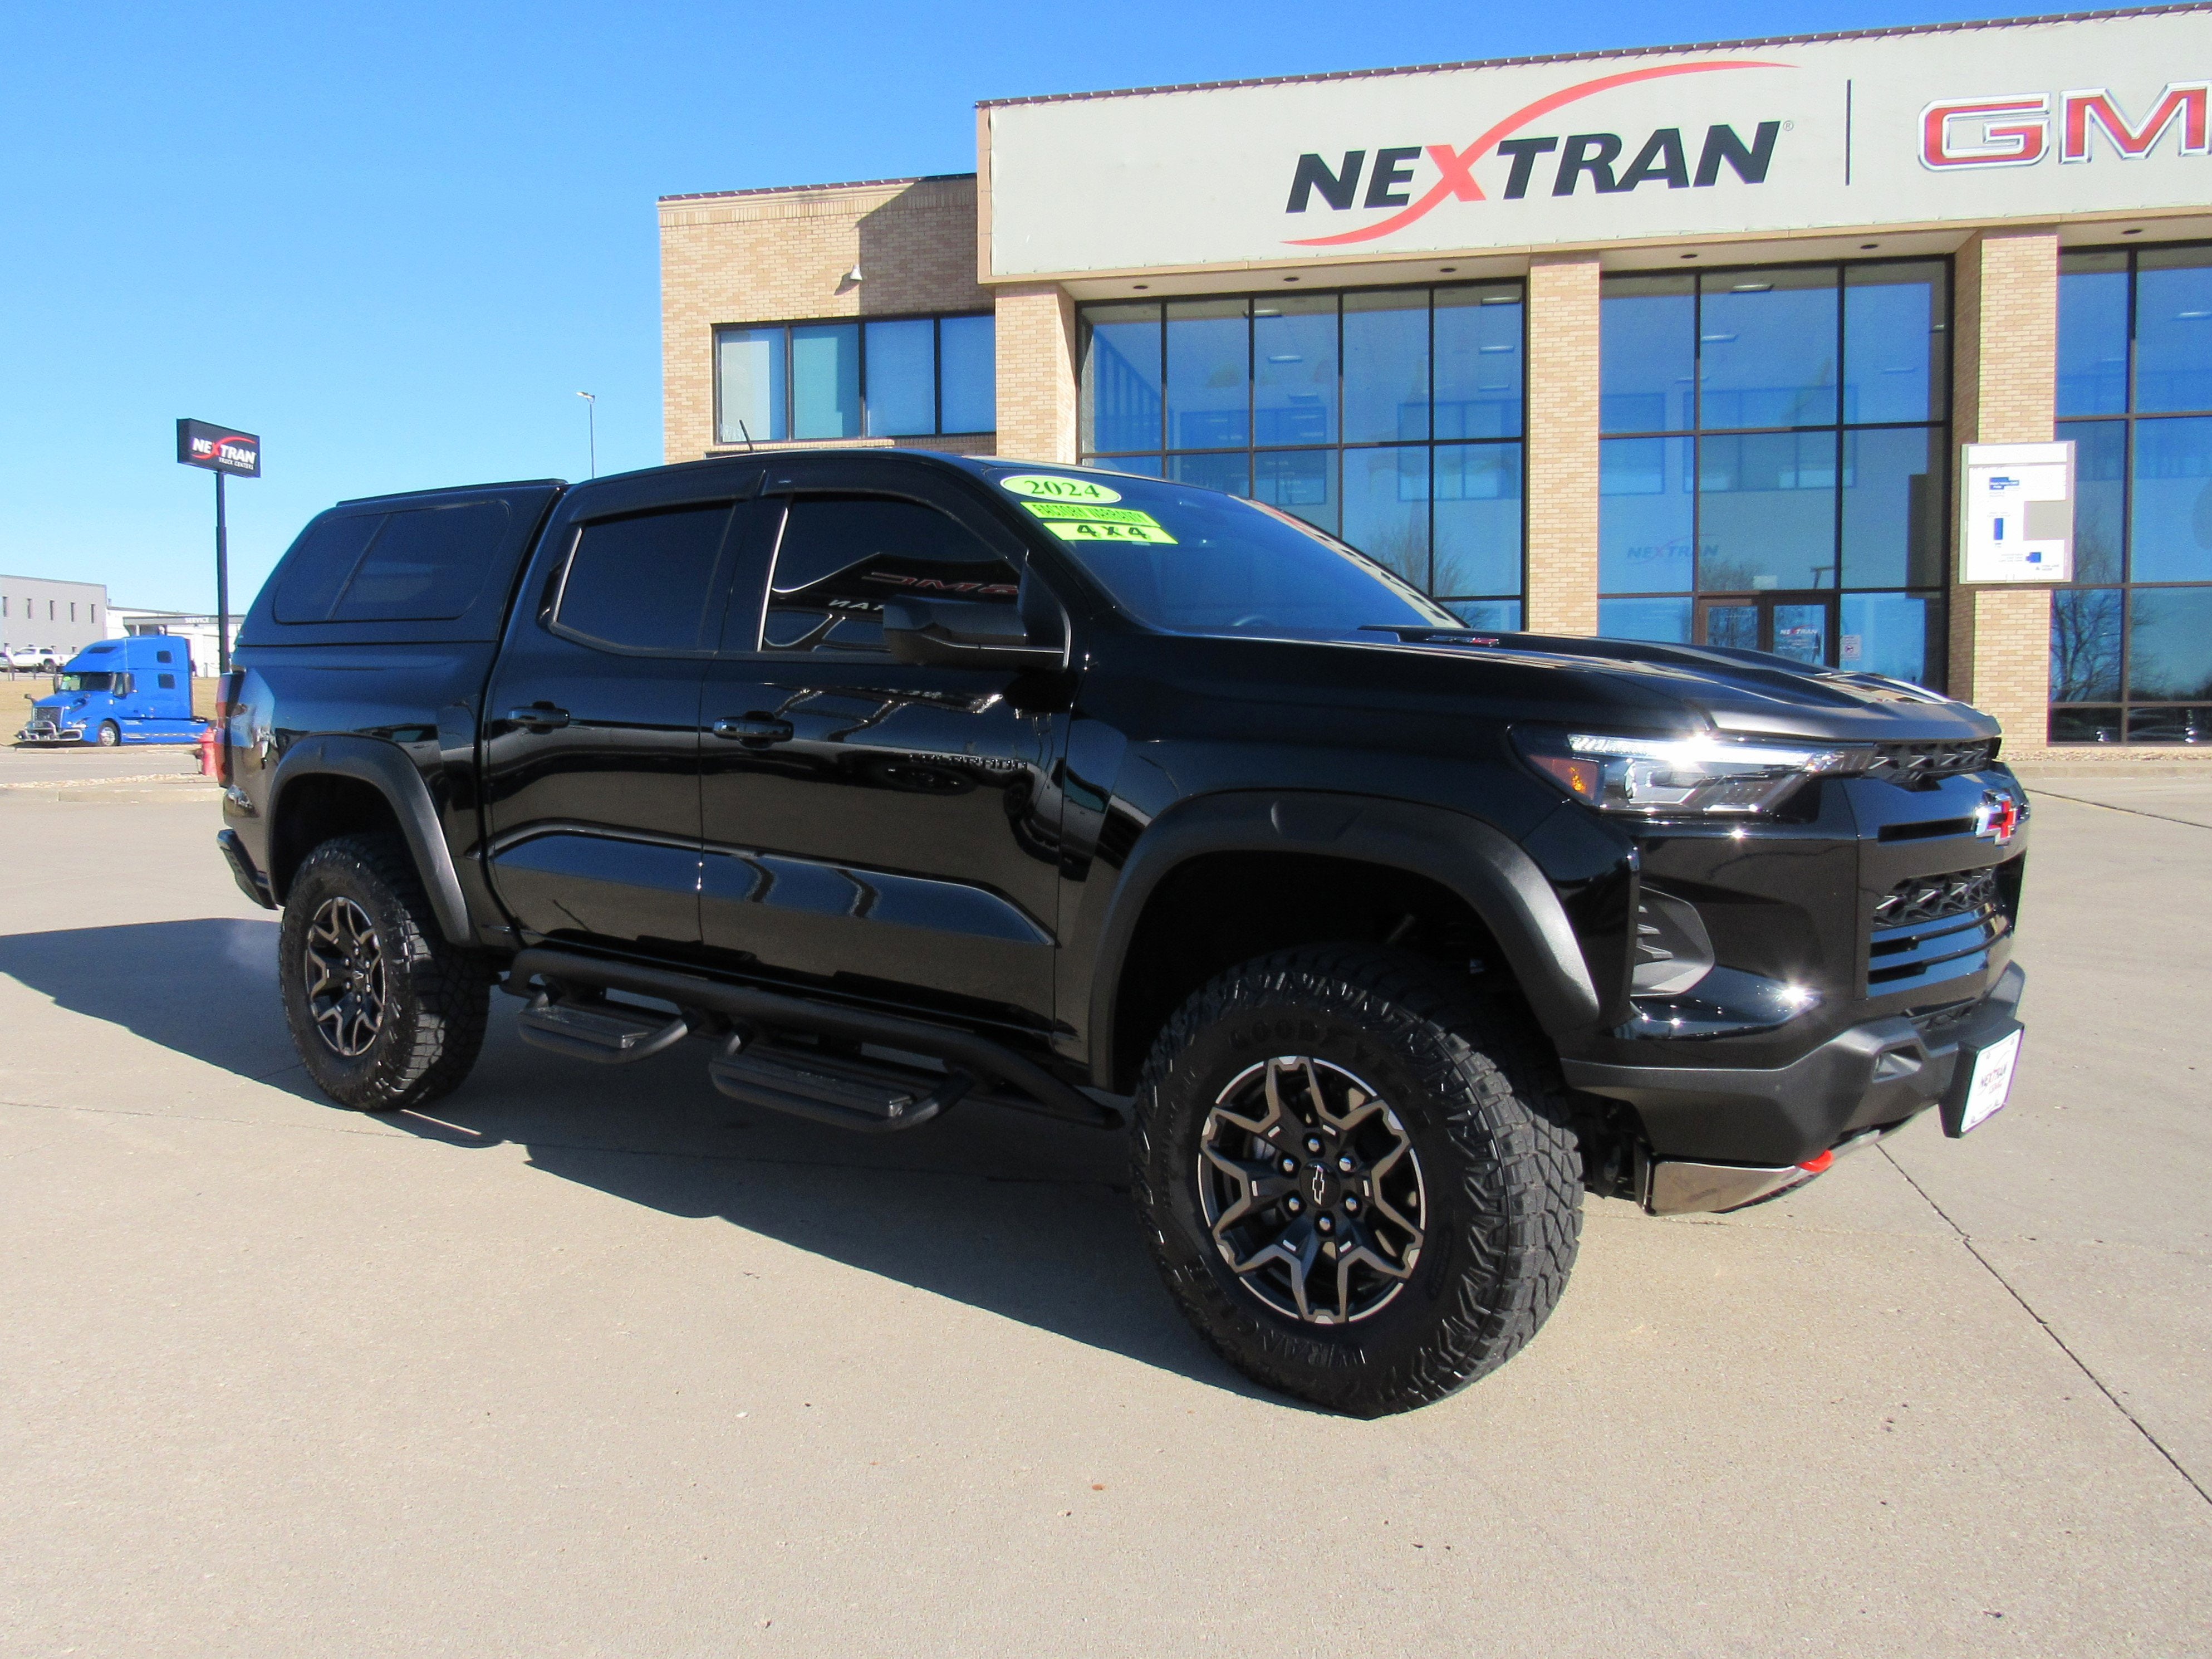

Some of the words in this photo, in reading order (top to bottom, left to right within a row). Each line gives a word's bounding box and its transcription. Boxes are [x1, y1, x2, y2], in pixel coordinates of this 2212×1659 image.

[1285, 120, 1782, 214] NEXTRAN
[192, 438, 257, 464] NEXTRAN
[1024, 480, 1101, 498] 2024
[909, 752, 1028, 771] COLORADO
